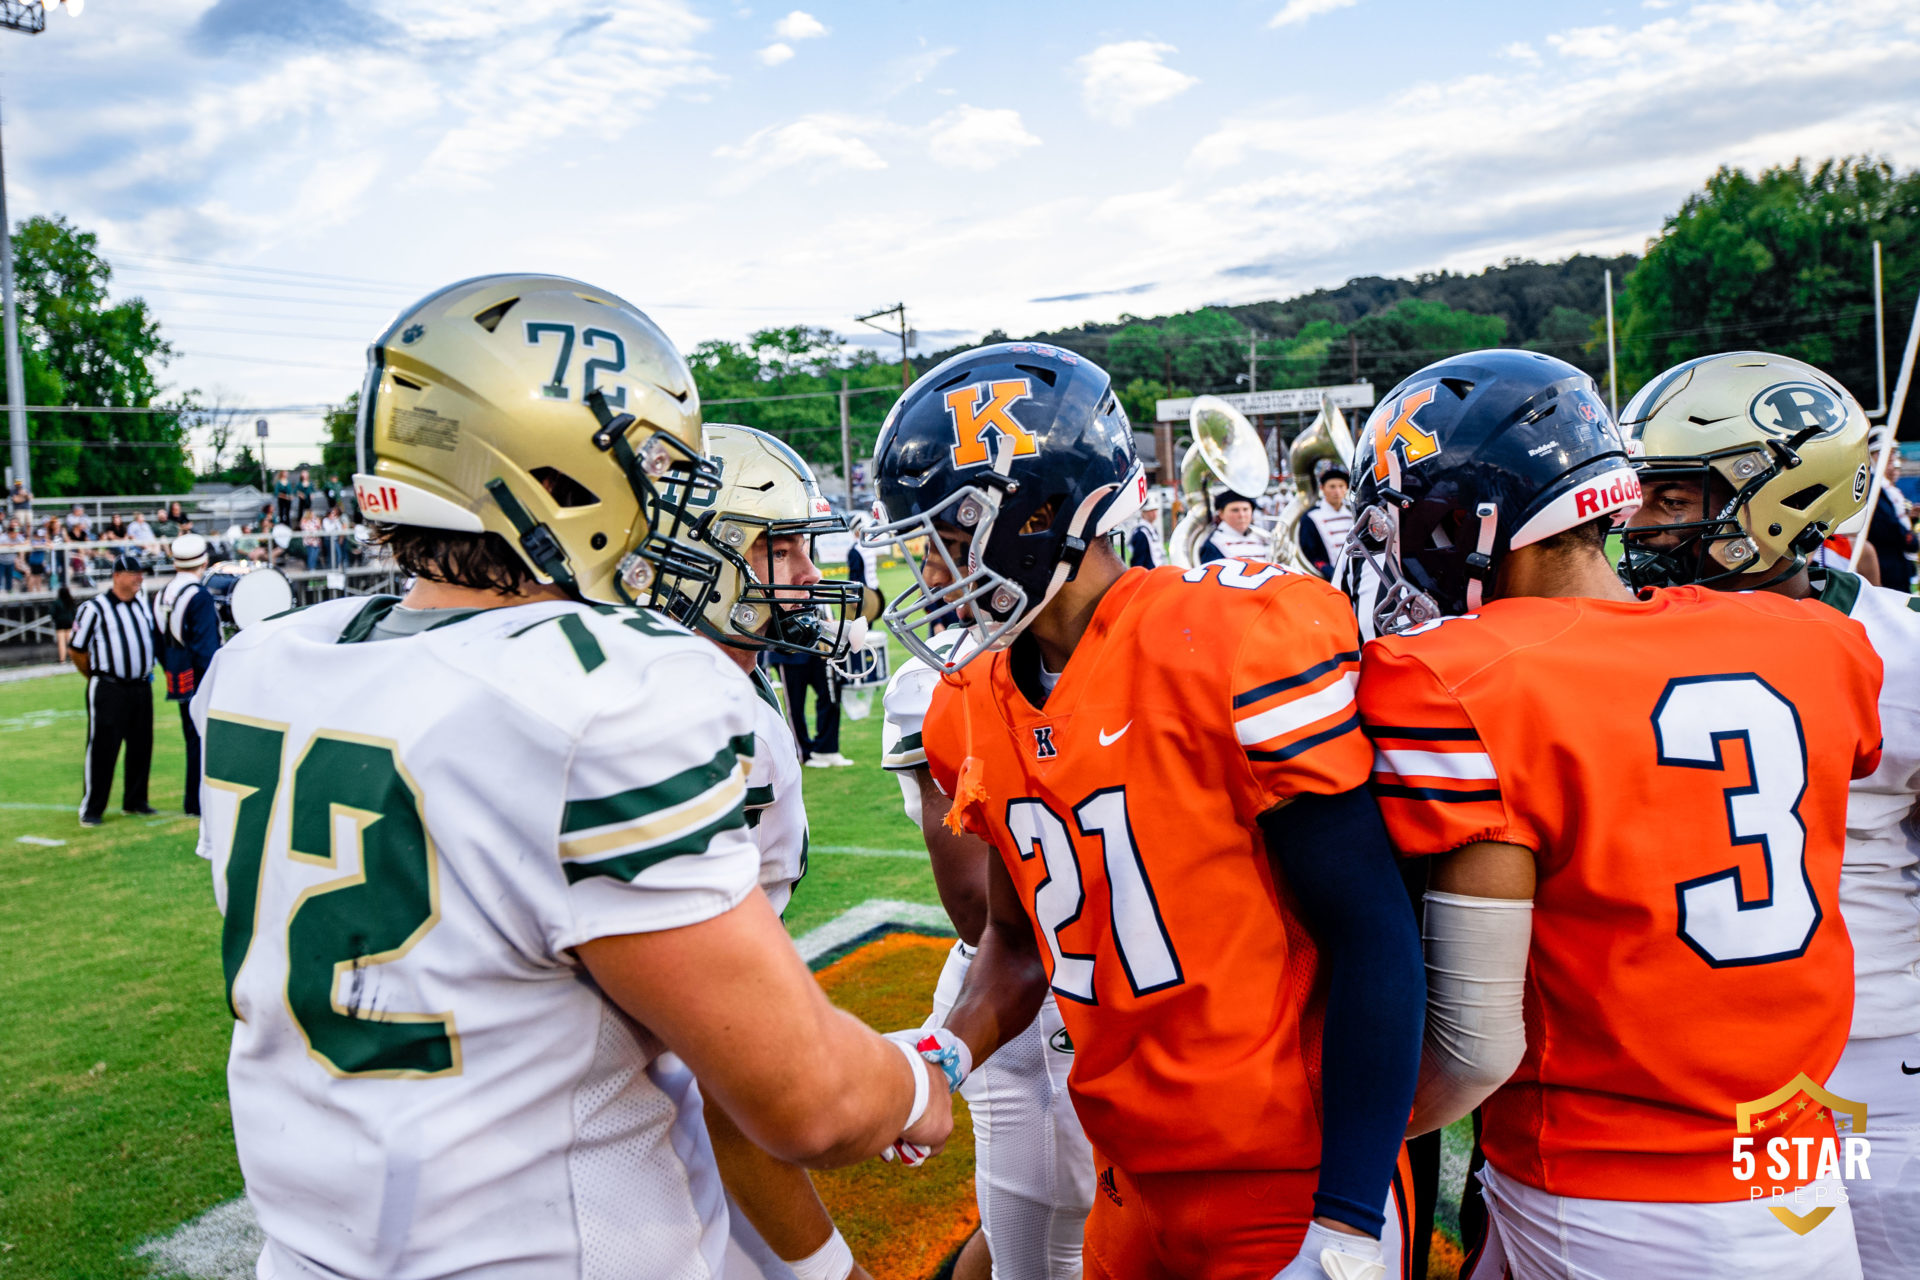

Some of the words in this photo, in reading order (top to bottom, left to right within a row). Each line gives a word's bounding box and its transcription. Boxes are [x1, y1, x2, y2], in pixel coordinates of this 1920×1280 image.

[523, 319, 627, 411] 72
[1763, 386, 1839, 433] R
[944, 378, 1041, 471] K
[1370, 383, 1442, 487] K
[1033, 726, 1057, 759] K
[1649, 671, 1823, 969] 3
[204, 709, 463, 1079] 72
[1005, 785, 1185, 1006] 21
